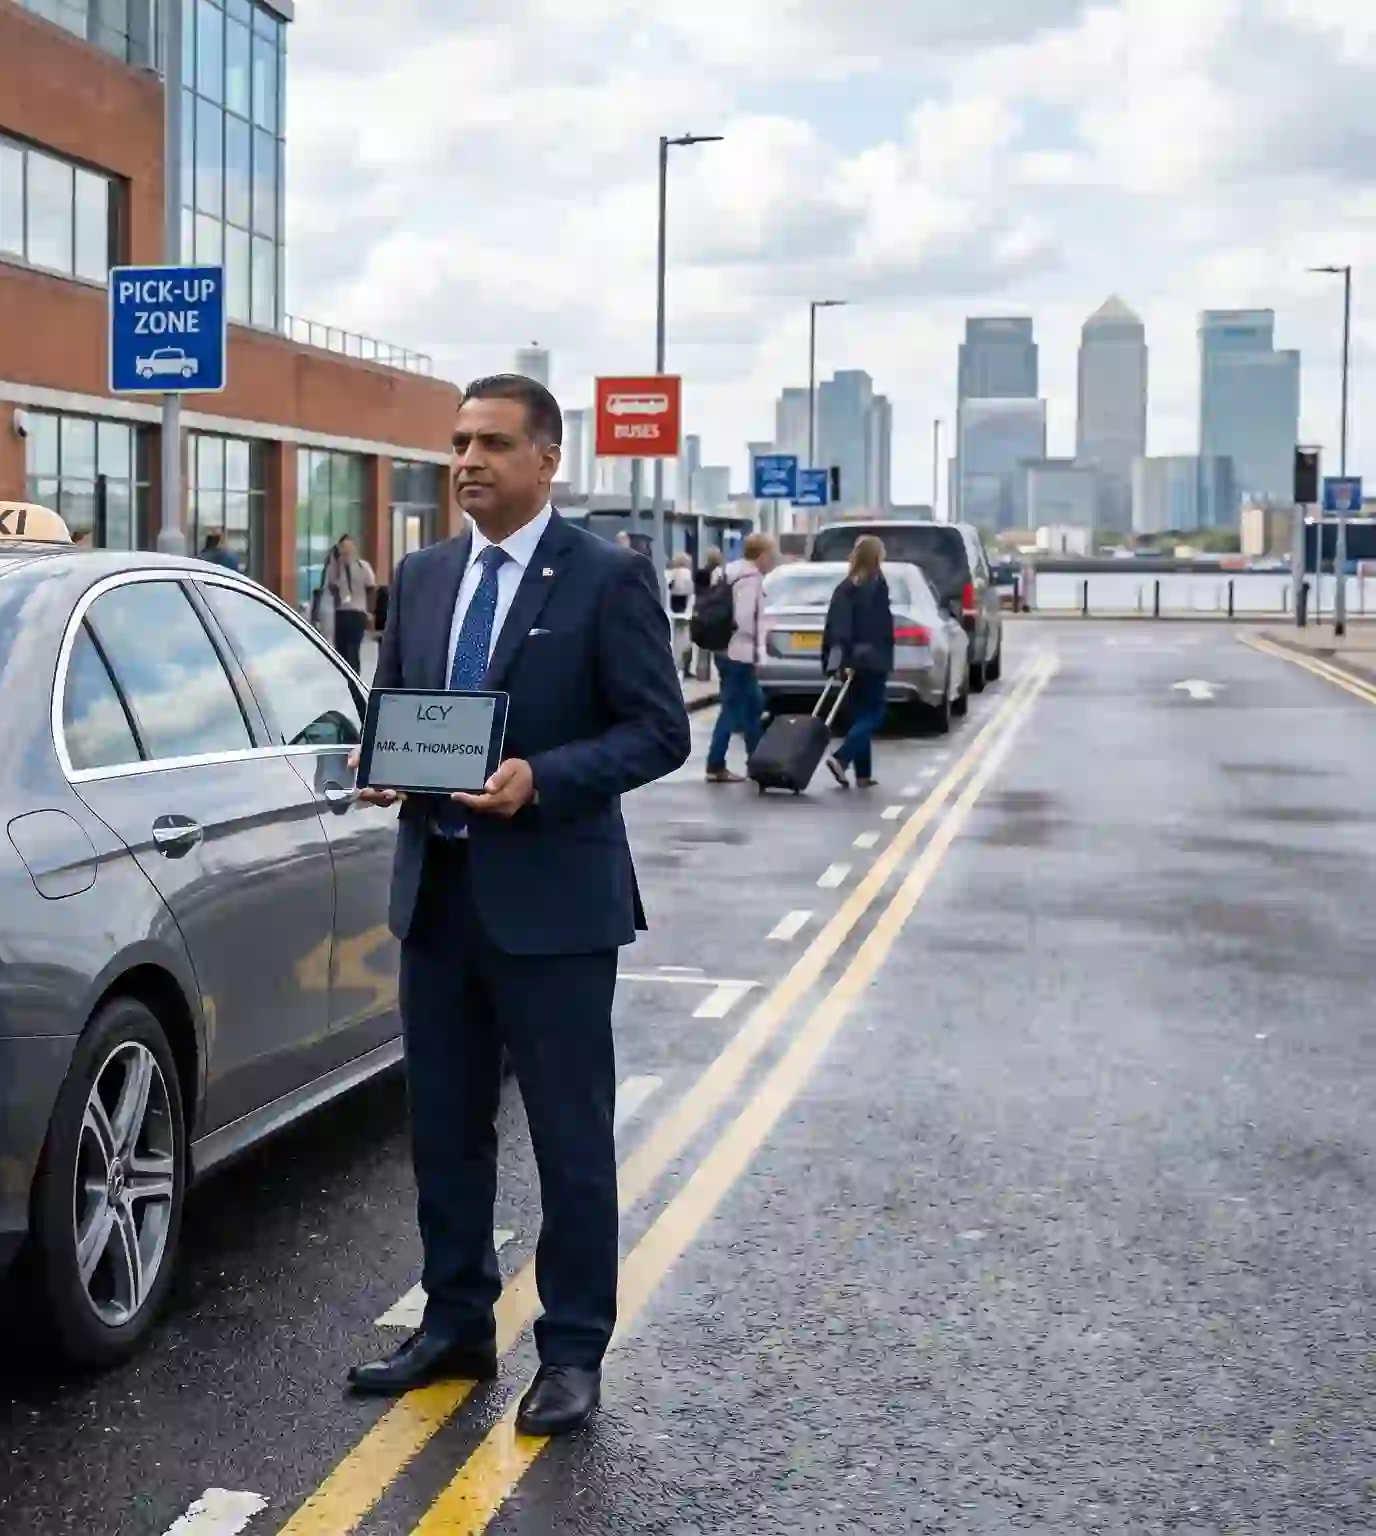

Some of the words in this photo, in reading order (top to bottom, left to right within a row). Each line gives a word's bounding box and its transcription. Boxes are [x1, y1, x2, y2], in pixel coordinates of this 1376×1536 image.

[119, 279, 216, 304] PICK-UP
[134, 310, 201, 334] ZONE
[416, 704, 452, 721] LCY
[376, 741, 399, 752] MR.
[401, 742, 413, 752] A.
[417, 742, 484, 755] THOMPSON
